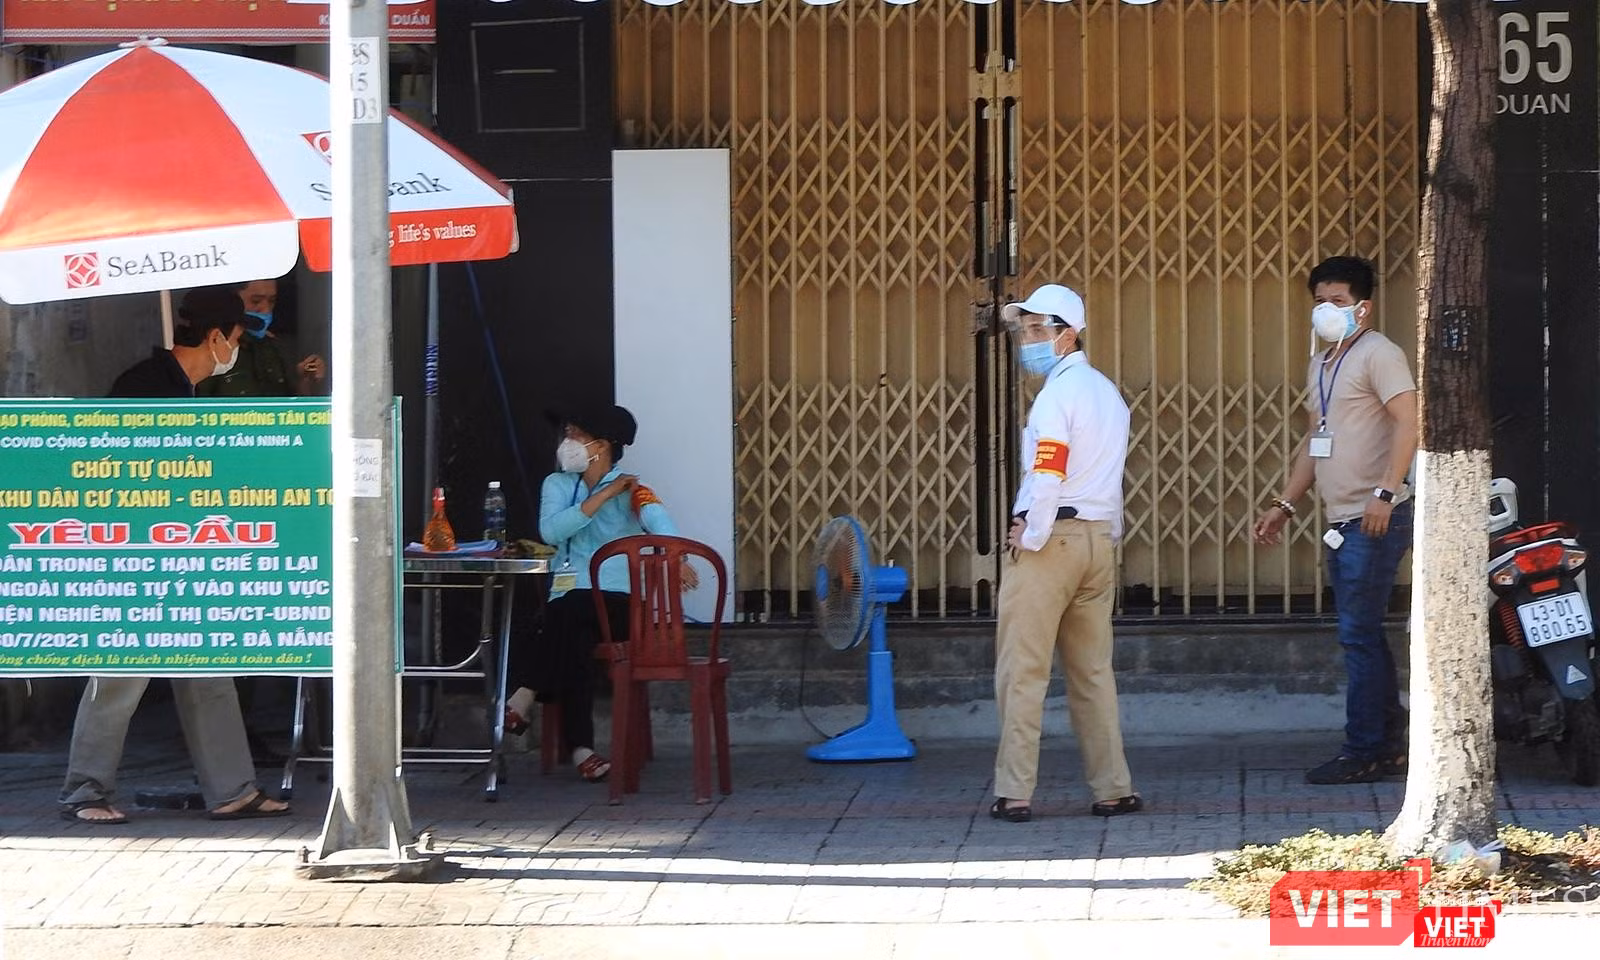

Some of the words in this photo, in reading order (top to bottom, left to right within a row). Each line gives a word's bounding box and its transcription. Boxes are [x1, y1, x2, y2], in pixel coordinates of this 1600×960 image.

[1499, 11, 1572, 84] 65
[434, 220, 477, 239] values
[107, 245, 229, 278] SeABank
[73, 409, 120, 427] CHỐNG
[121, 413, 155, 429] DỊCH
[156, 412, 218, 427] COVID-19
[277, 410, 306, 426] TÂN
[0, 436, 44, 449] COVID
[45, 433, 88, 451] CỘNG
[89, 431, 132, 449] ĐỒNG
[133, 435, 161, 448] KHU
[162, 433, 193, 448] DÂN
[194, 434, 216, 448] CƯ
[217, 435, 227, 448] 4
[227, 432, 255, 447] TÂN
[256, 434, 291, 448] NINH
[292, 434, 304, 447] A
[71, 454, 123, 479] CHỐT
[127, 459, 155, 482] TỰ
[157, 454, 213, 480] QUẢN
[37, 486, 80, 508] DÂN
[84, 488, 114, 508] CƯ
[116, 489, 171, 508] XANH
[189, 488, 225, 507] GIA
[228, 485, 278, 507] ĐÌNH
[282, 488, 312, 506] AN
[8, 518, 131, 546] YÊU
[149, 514, 277, 546] CẦU
[0, 554, 34, 573] ÂN
[37, 557, 108, 572] TRONG
[112, 557, 156, 573] KDC
[160, 556, 206, 575] HẠN
[210, 552, 254, 572] CHẾ
[256, 556, 280, 571] ĐI
[284, 556, 319, 574] LẠI
[0, 579, 60, 597] NGOÀI
[64, 579, 138, 597] KHÔNG
[142, 581, 171, 600] TỰ
[173, 579, 188, 597] Ý
[192, 579, 235, 596] VÀO
[239, 581, 283, 596] KHU
[287, 579, 331, 599] VỰC
[38, 605, 123, 623] NGHIÊM
[127, 602, 164, 622] CHỈ
[167, 606, 202, 625] THỊ
[206, 606, 332, 622] 05/CT-UBND
[1530, 598, 1574, 623] 43-D1
[0, 632, 89, 648] 0/7/2021
[96, 628, 141, 648] CỦA
[145, 632, 203, 648] UBND
[208, 632, 238, 648] TP.
[242, 629, 273, 647] ĐÀ
[1530, 614, 1588, 643] 880.65
[26, 653, 70, 667] chống
[72, 653, 103, 668] dịch
[123, 653, 162, 665] trách
[165, 653, 209, 667] nhiệm
